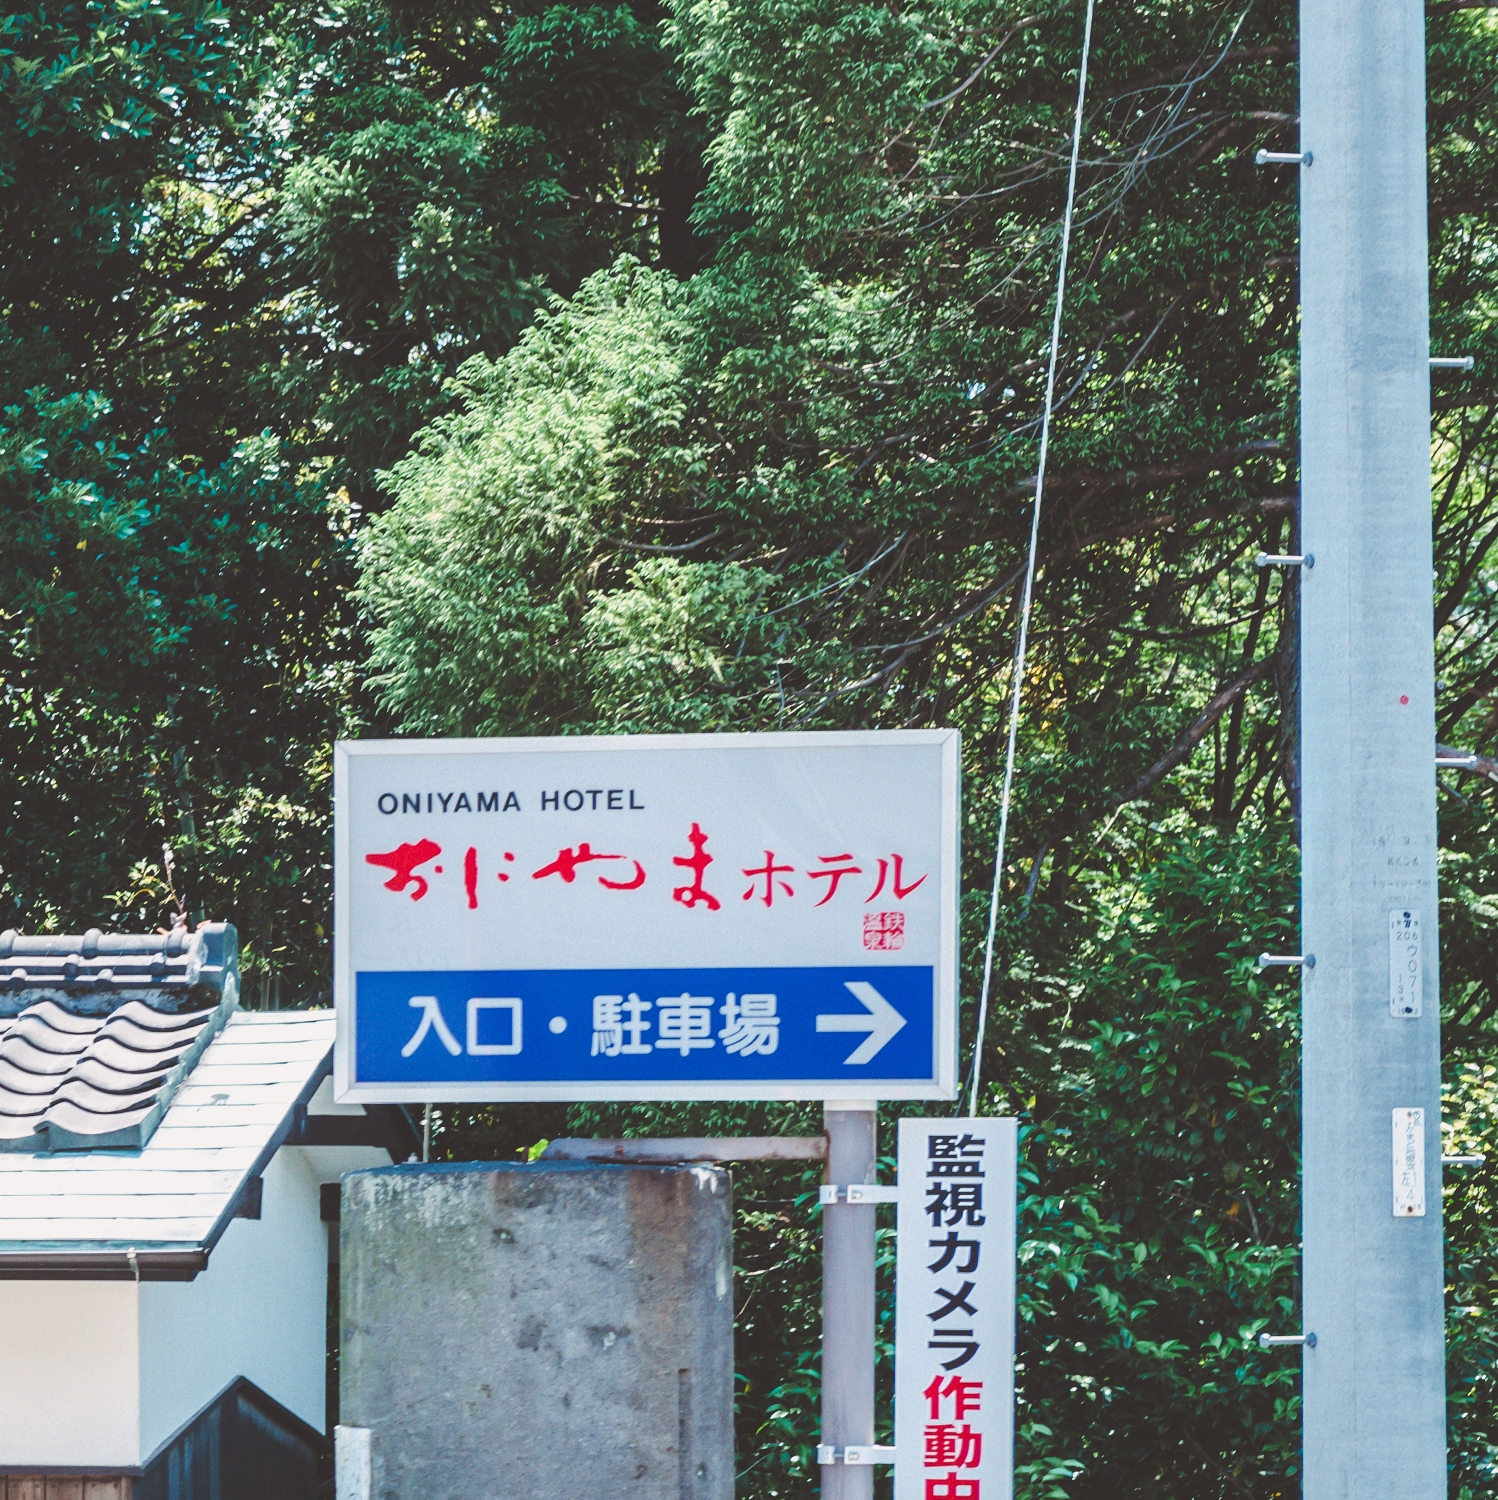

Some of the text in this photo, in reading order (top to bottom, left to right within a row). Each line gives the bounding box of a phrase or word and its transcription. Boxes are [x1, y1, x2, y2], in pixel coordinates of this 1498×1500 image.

[377, 788, 645, 815] ONIYAMA HOTEL
[400, 992, 781, 1058] 入口・駐車場
